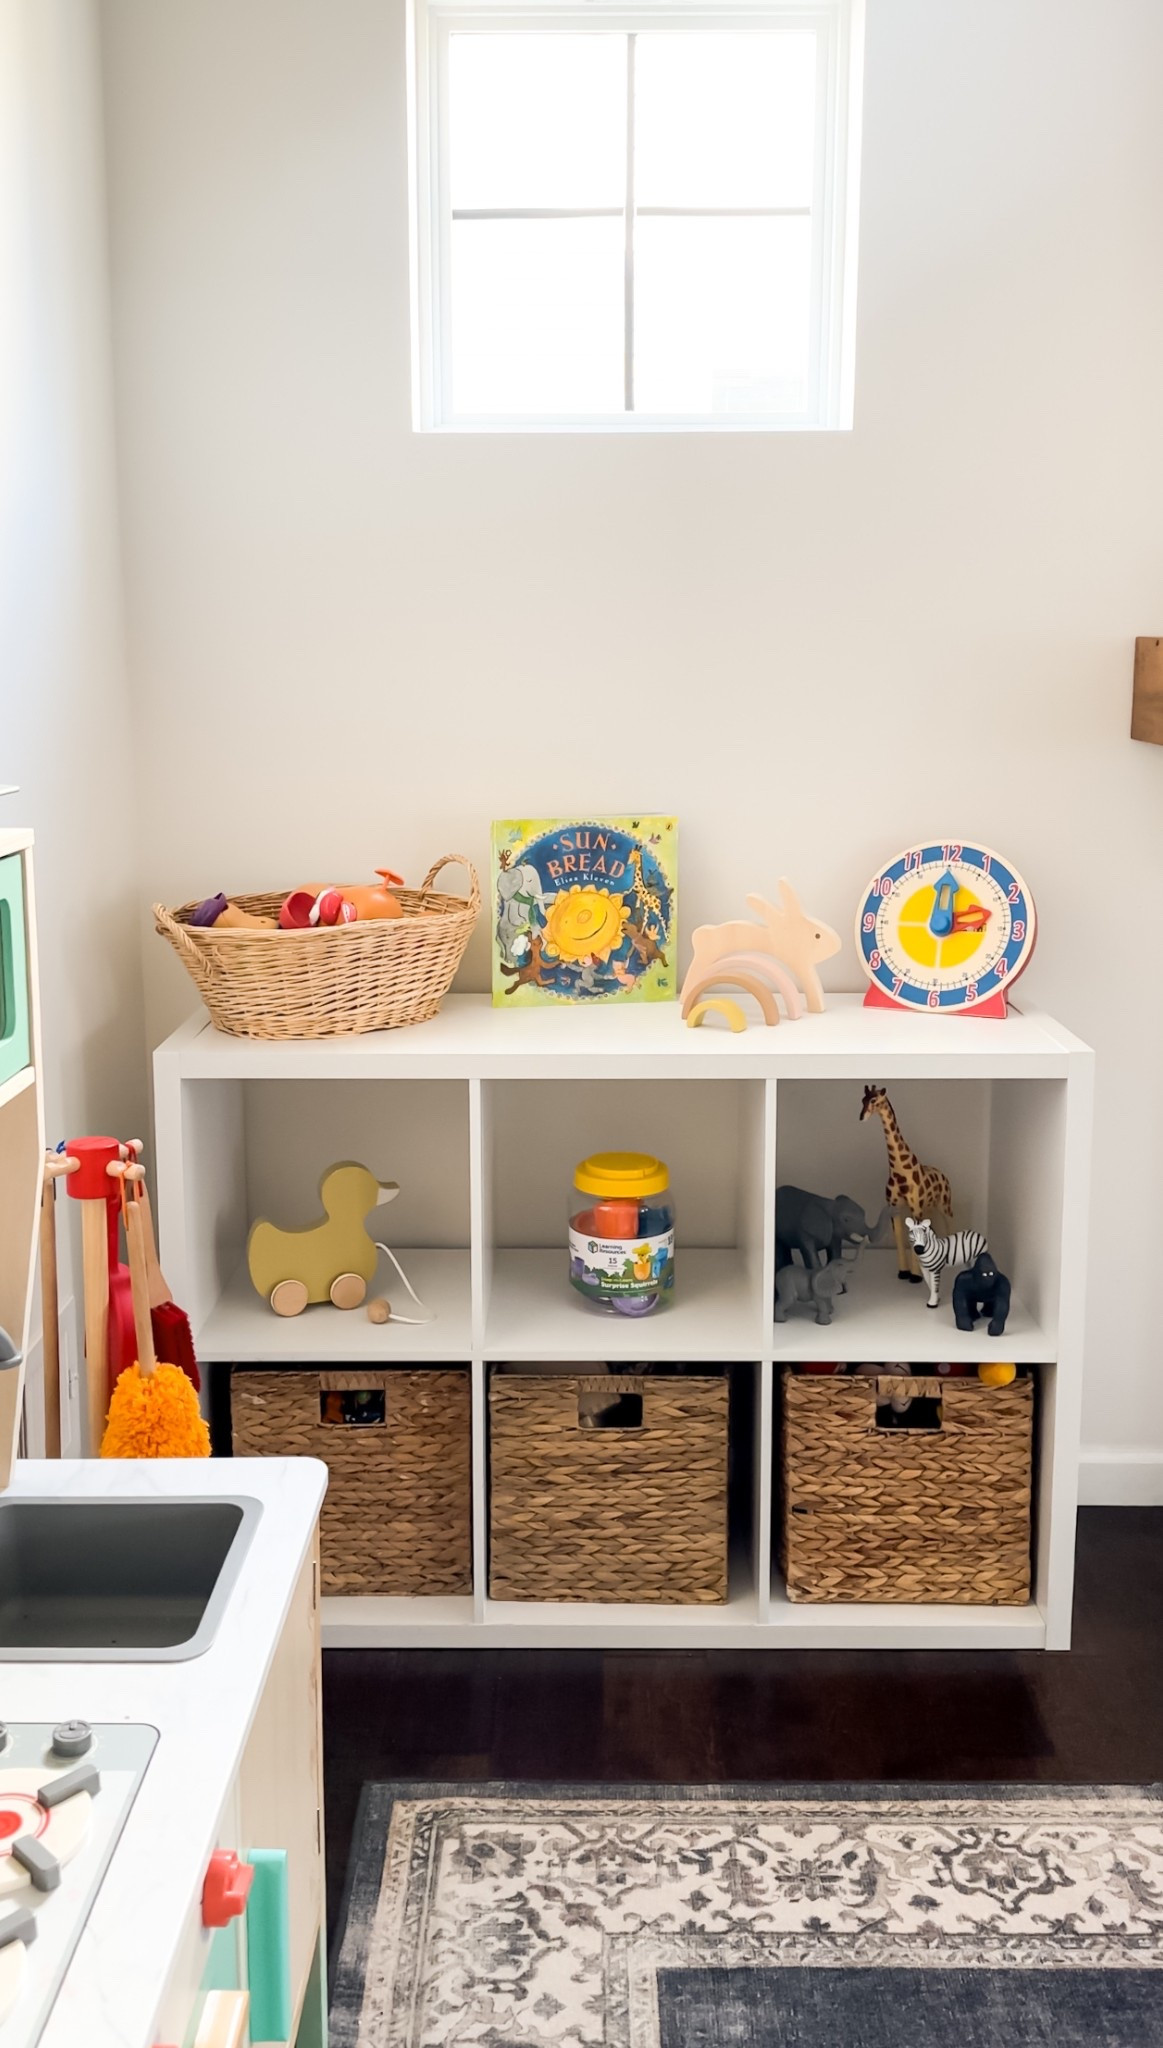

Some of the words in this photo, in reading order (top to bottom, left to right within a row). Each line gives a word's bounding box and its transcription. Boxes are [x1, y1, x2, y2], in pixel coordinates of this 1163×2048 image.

[560, 831, 611, 852] SUN
[904, 851, 921, 870] 11
[942, 844, 962, 863] 12
[546, 852, 625, 879] BREAD
[982, 854, 991, 873] 1
[554, 876, 579, 887] Elisa
[873, 878, 892, 896] 10
[1008, 884, 1020, 903] 2
[864, 912, 875, 932] 9
[1012, 921, 1025, 940] 3
[869, 950, 881, 969] 8
[995, 958, 1007, 977] 4
[892, 978, 903, 996] 7
[966, 983, 977, 1002] 5
[928, 990, 939, 1008] 6
[601, 1281, 629, 1290] Surprise
